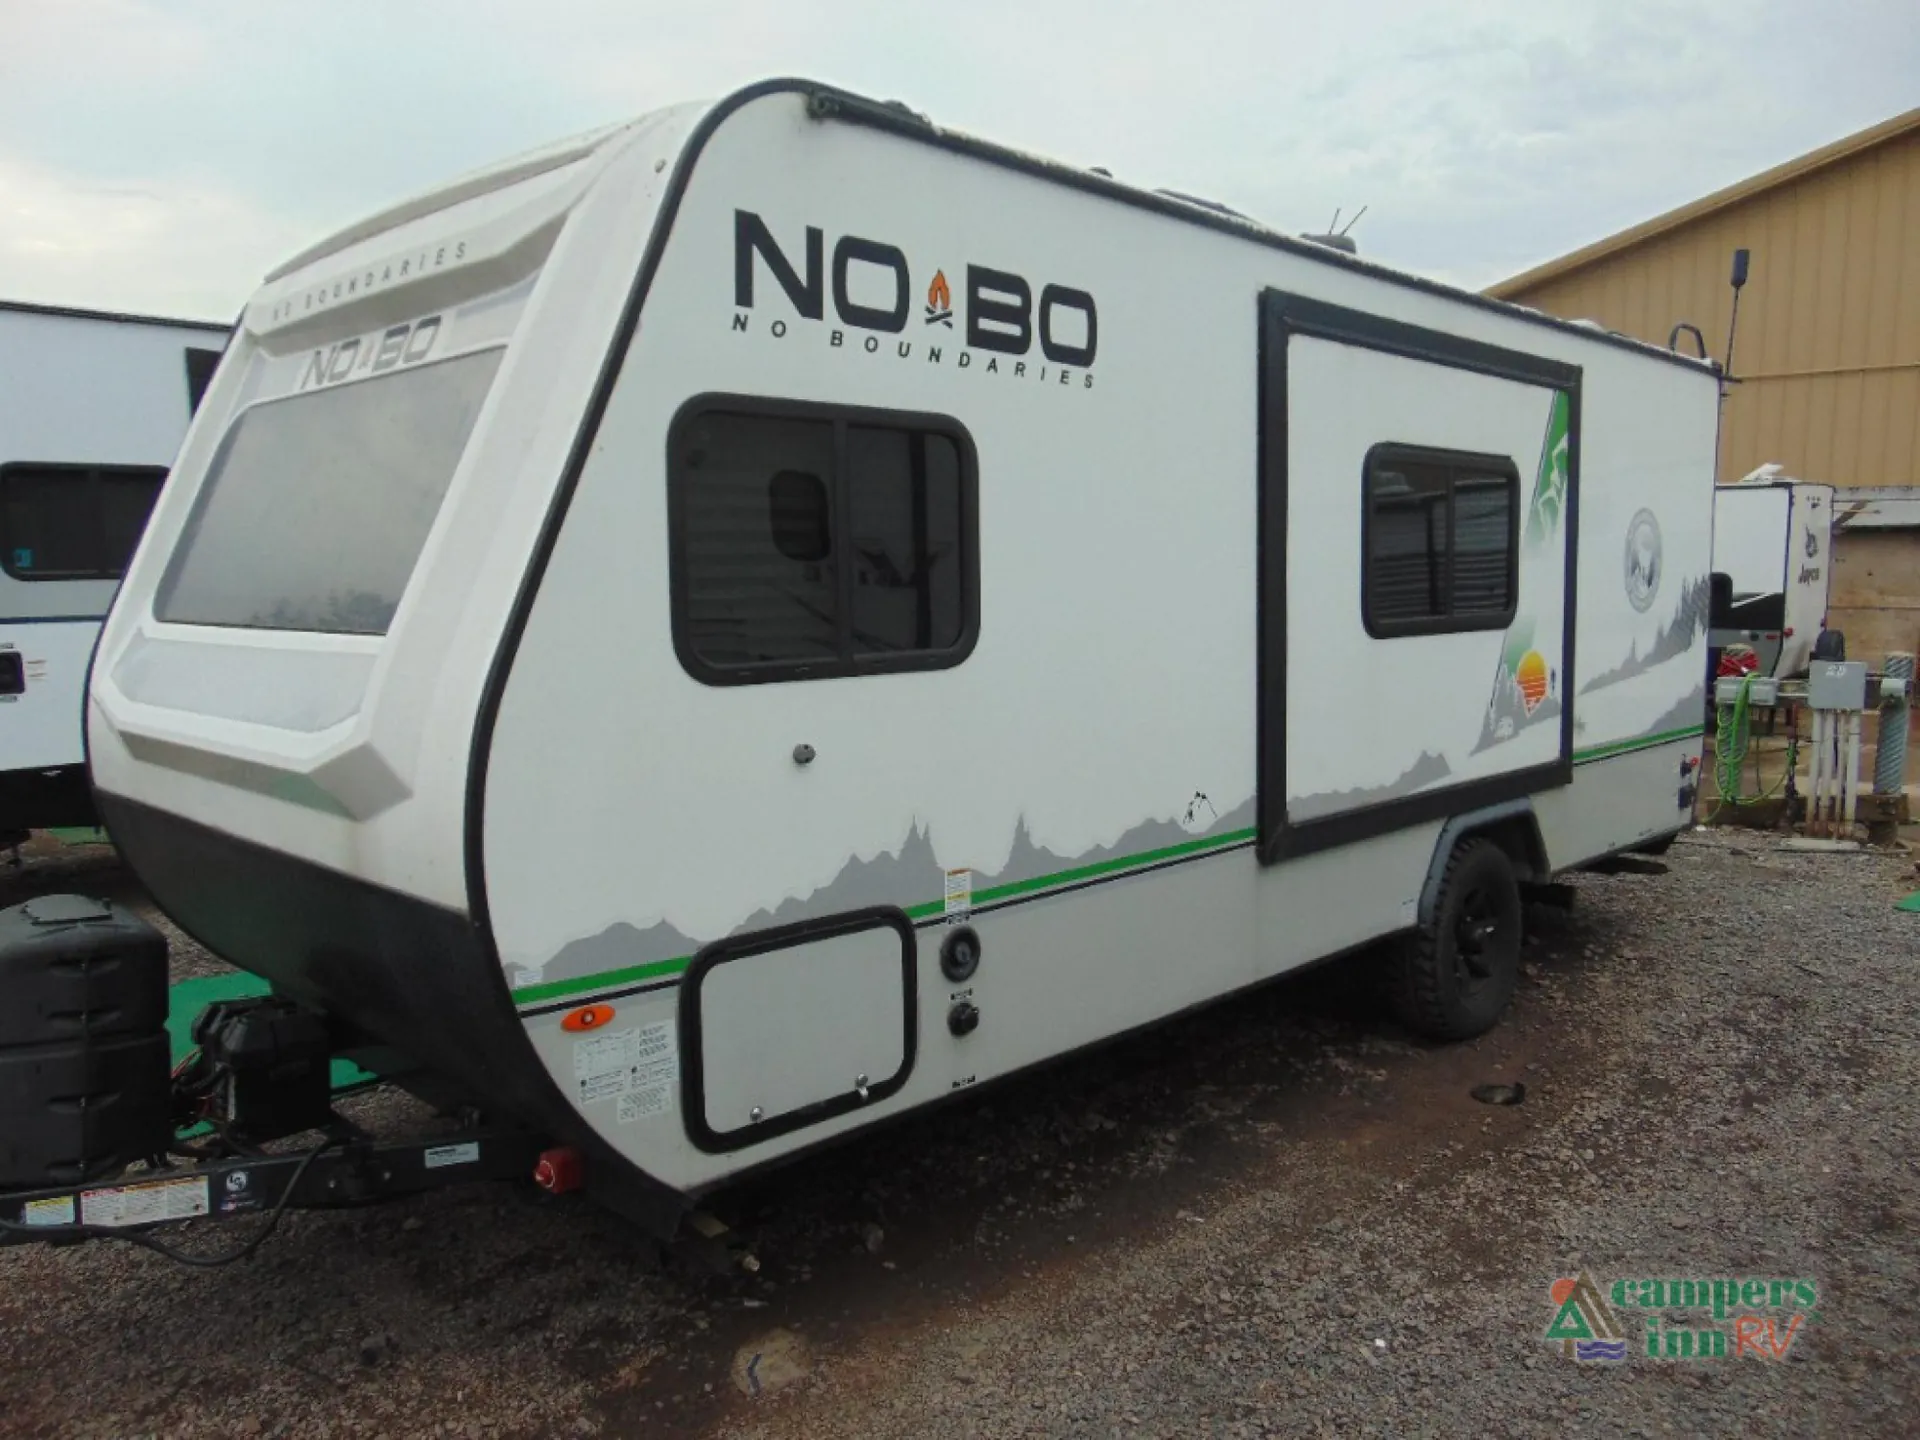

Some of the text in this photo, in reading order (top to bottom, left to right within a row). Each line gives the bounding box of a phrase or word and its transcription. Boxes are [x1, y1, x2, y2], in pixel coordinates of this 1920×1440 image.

[305, 242, 467, 309] BOUNDARIES
[731, 313, 1094, 389] NO BOUNDARIES
